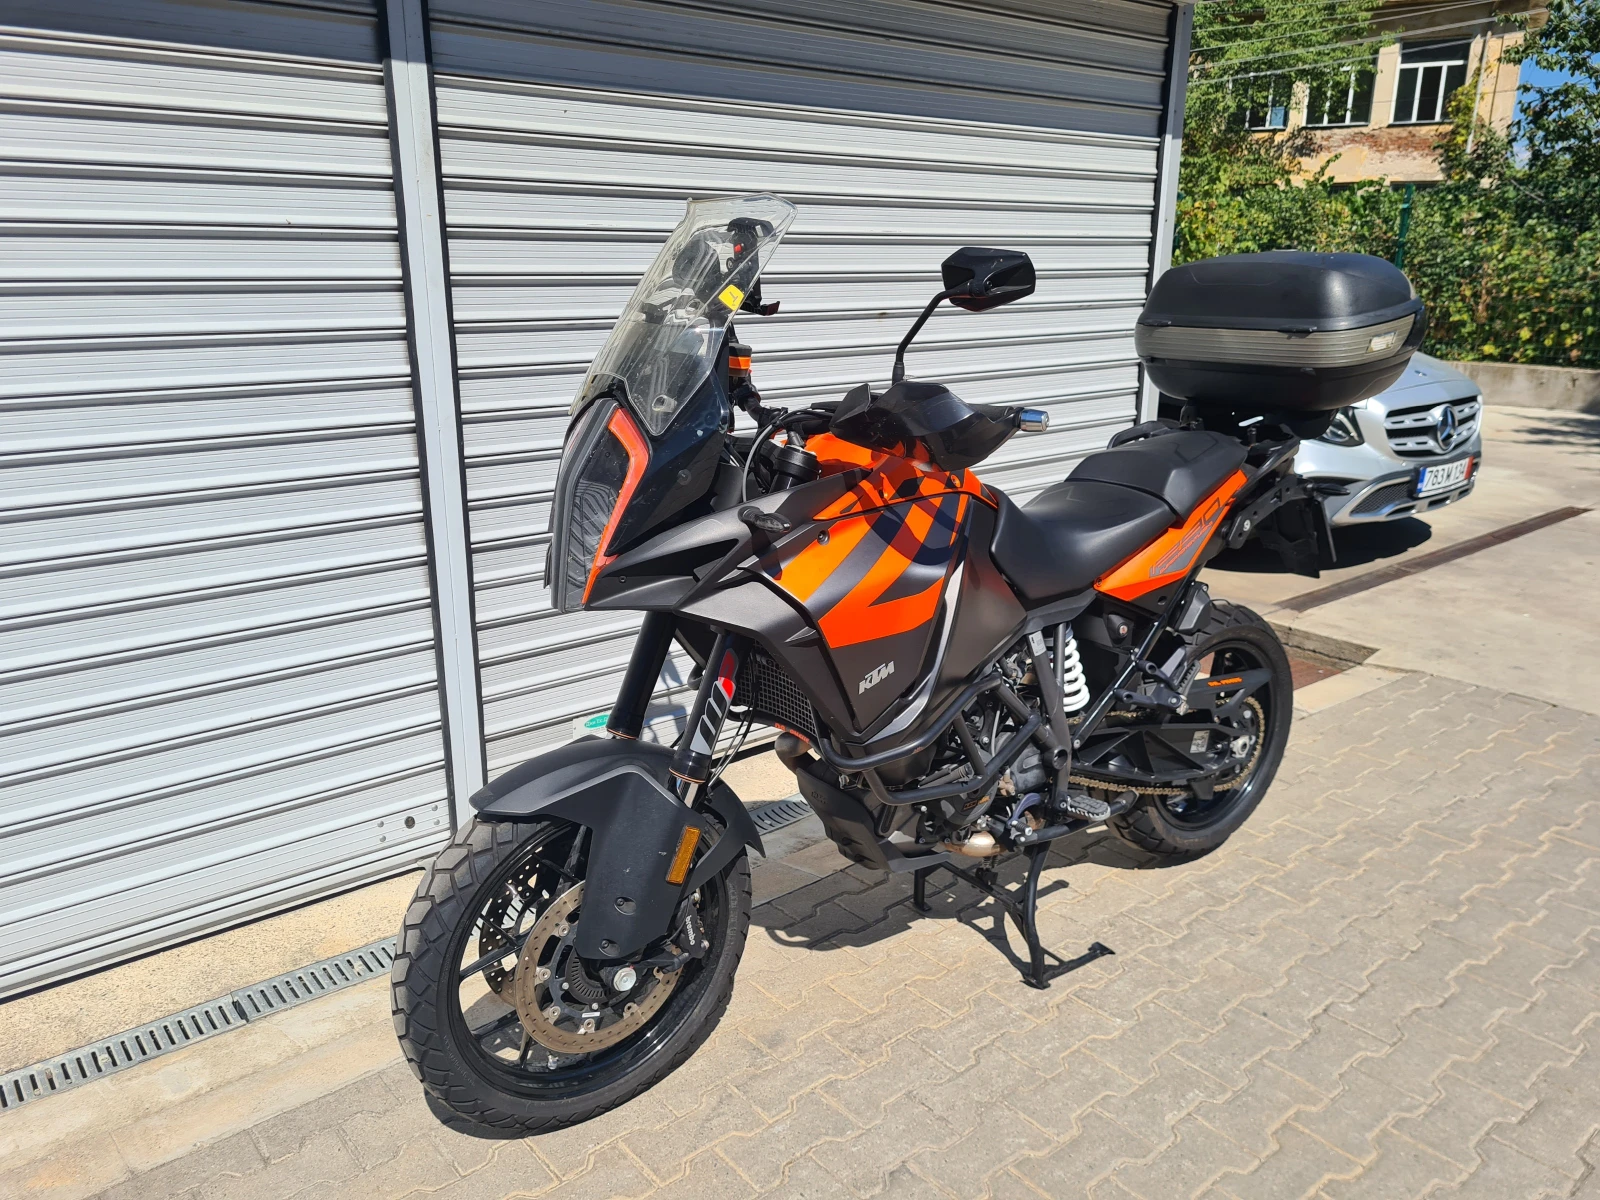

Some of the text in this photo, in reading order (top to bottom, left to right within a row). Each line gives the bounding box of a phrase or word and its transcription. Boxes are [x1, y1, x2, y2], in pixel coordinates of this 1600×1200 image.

[1425, 468, 1445, 488] 783
[859, 660, 895, 695] KTM
[686, 914, 696, 946] brembo
